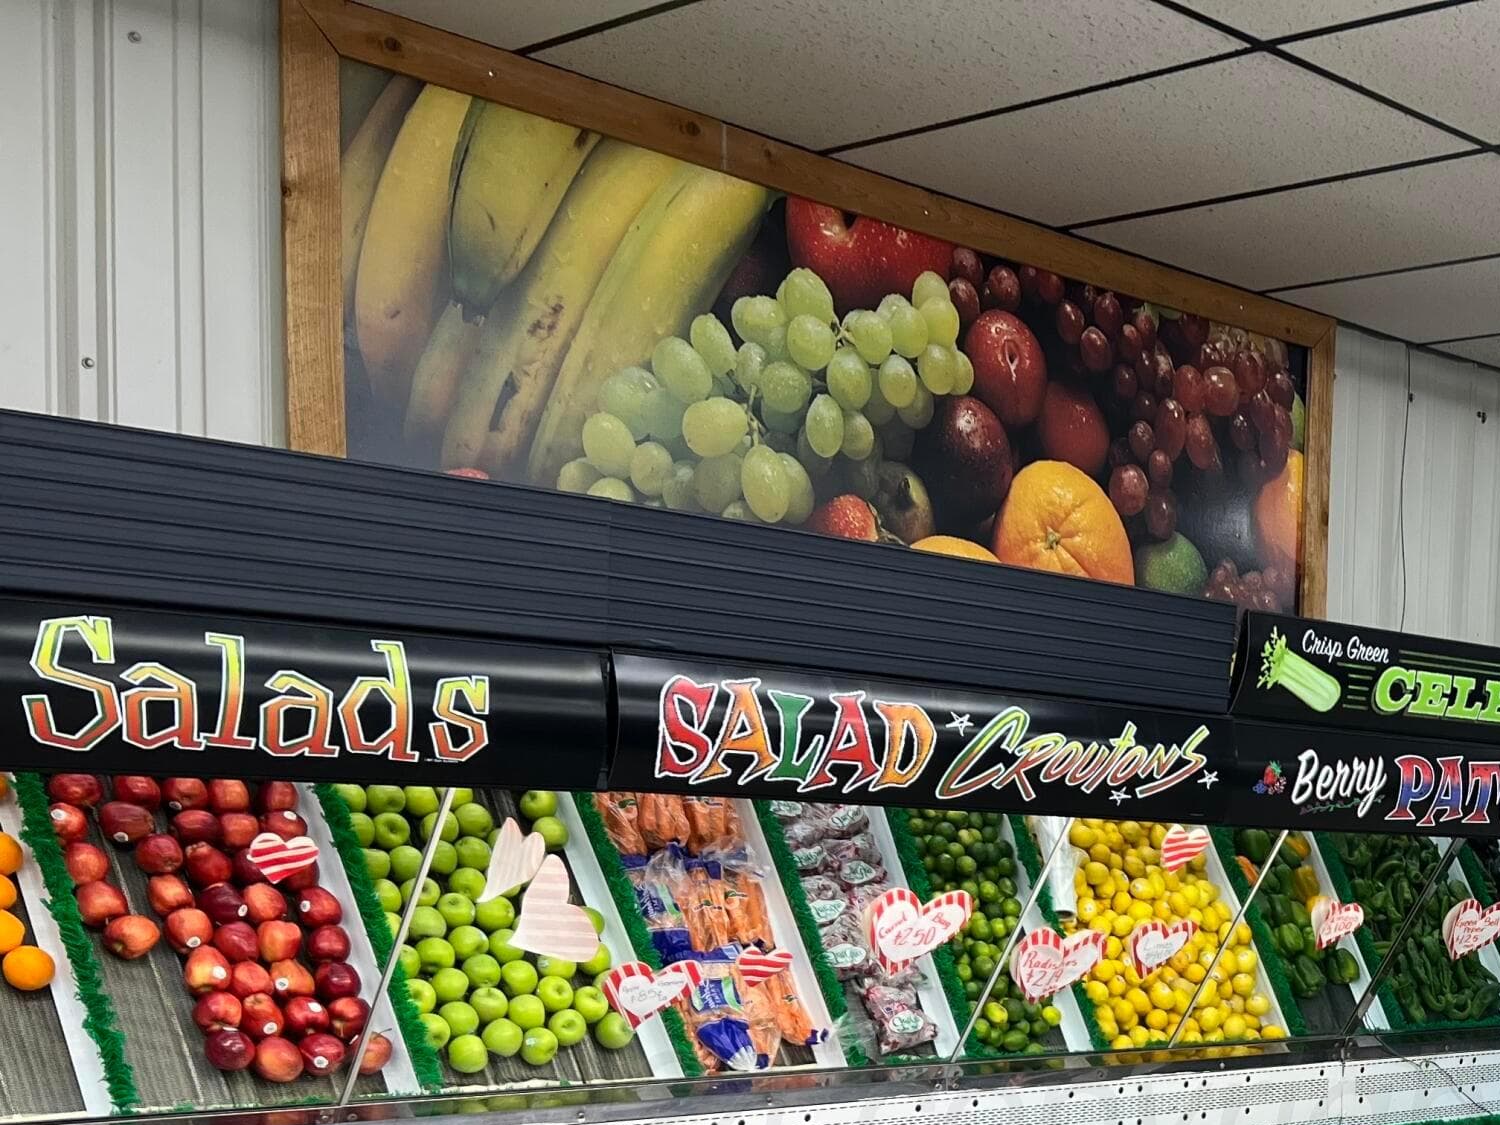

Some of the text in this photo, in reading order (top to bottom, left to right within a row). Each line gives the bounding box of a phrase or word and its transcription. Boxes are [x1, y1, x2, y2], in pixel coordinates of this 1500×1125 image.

[22, 616, 489, 762] Salads
[1302, 629, 1389, 665] Crisp Green
[655, 675, 937, 794] SALAD
[1291, 749, 1387, 818] Berry
